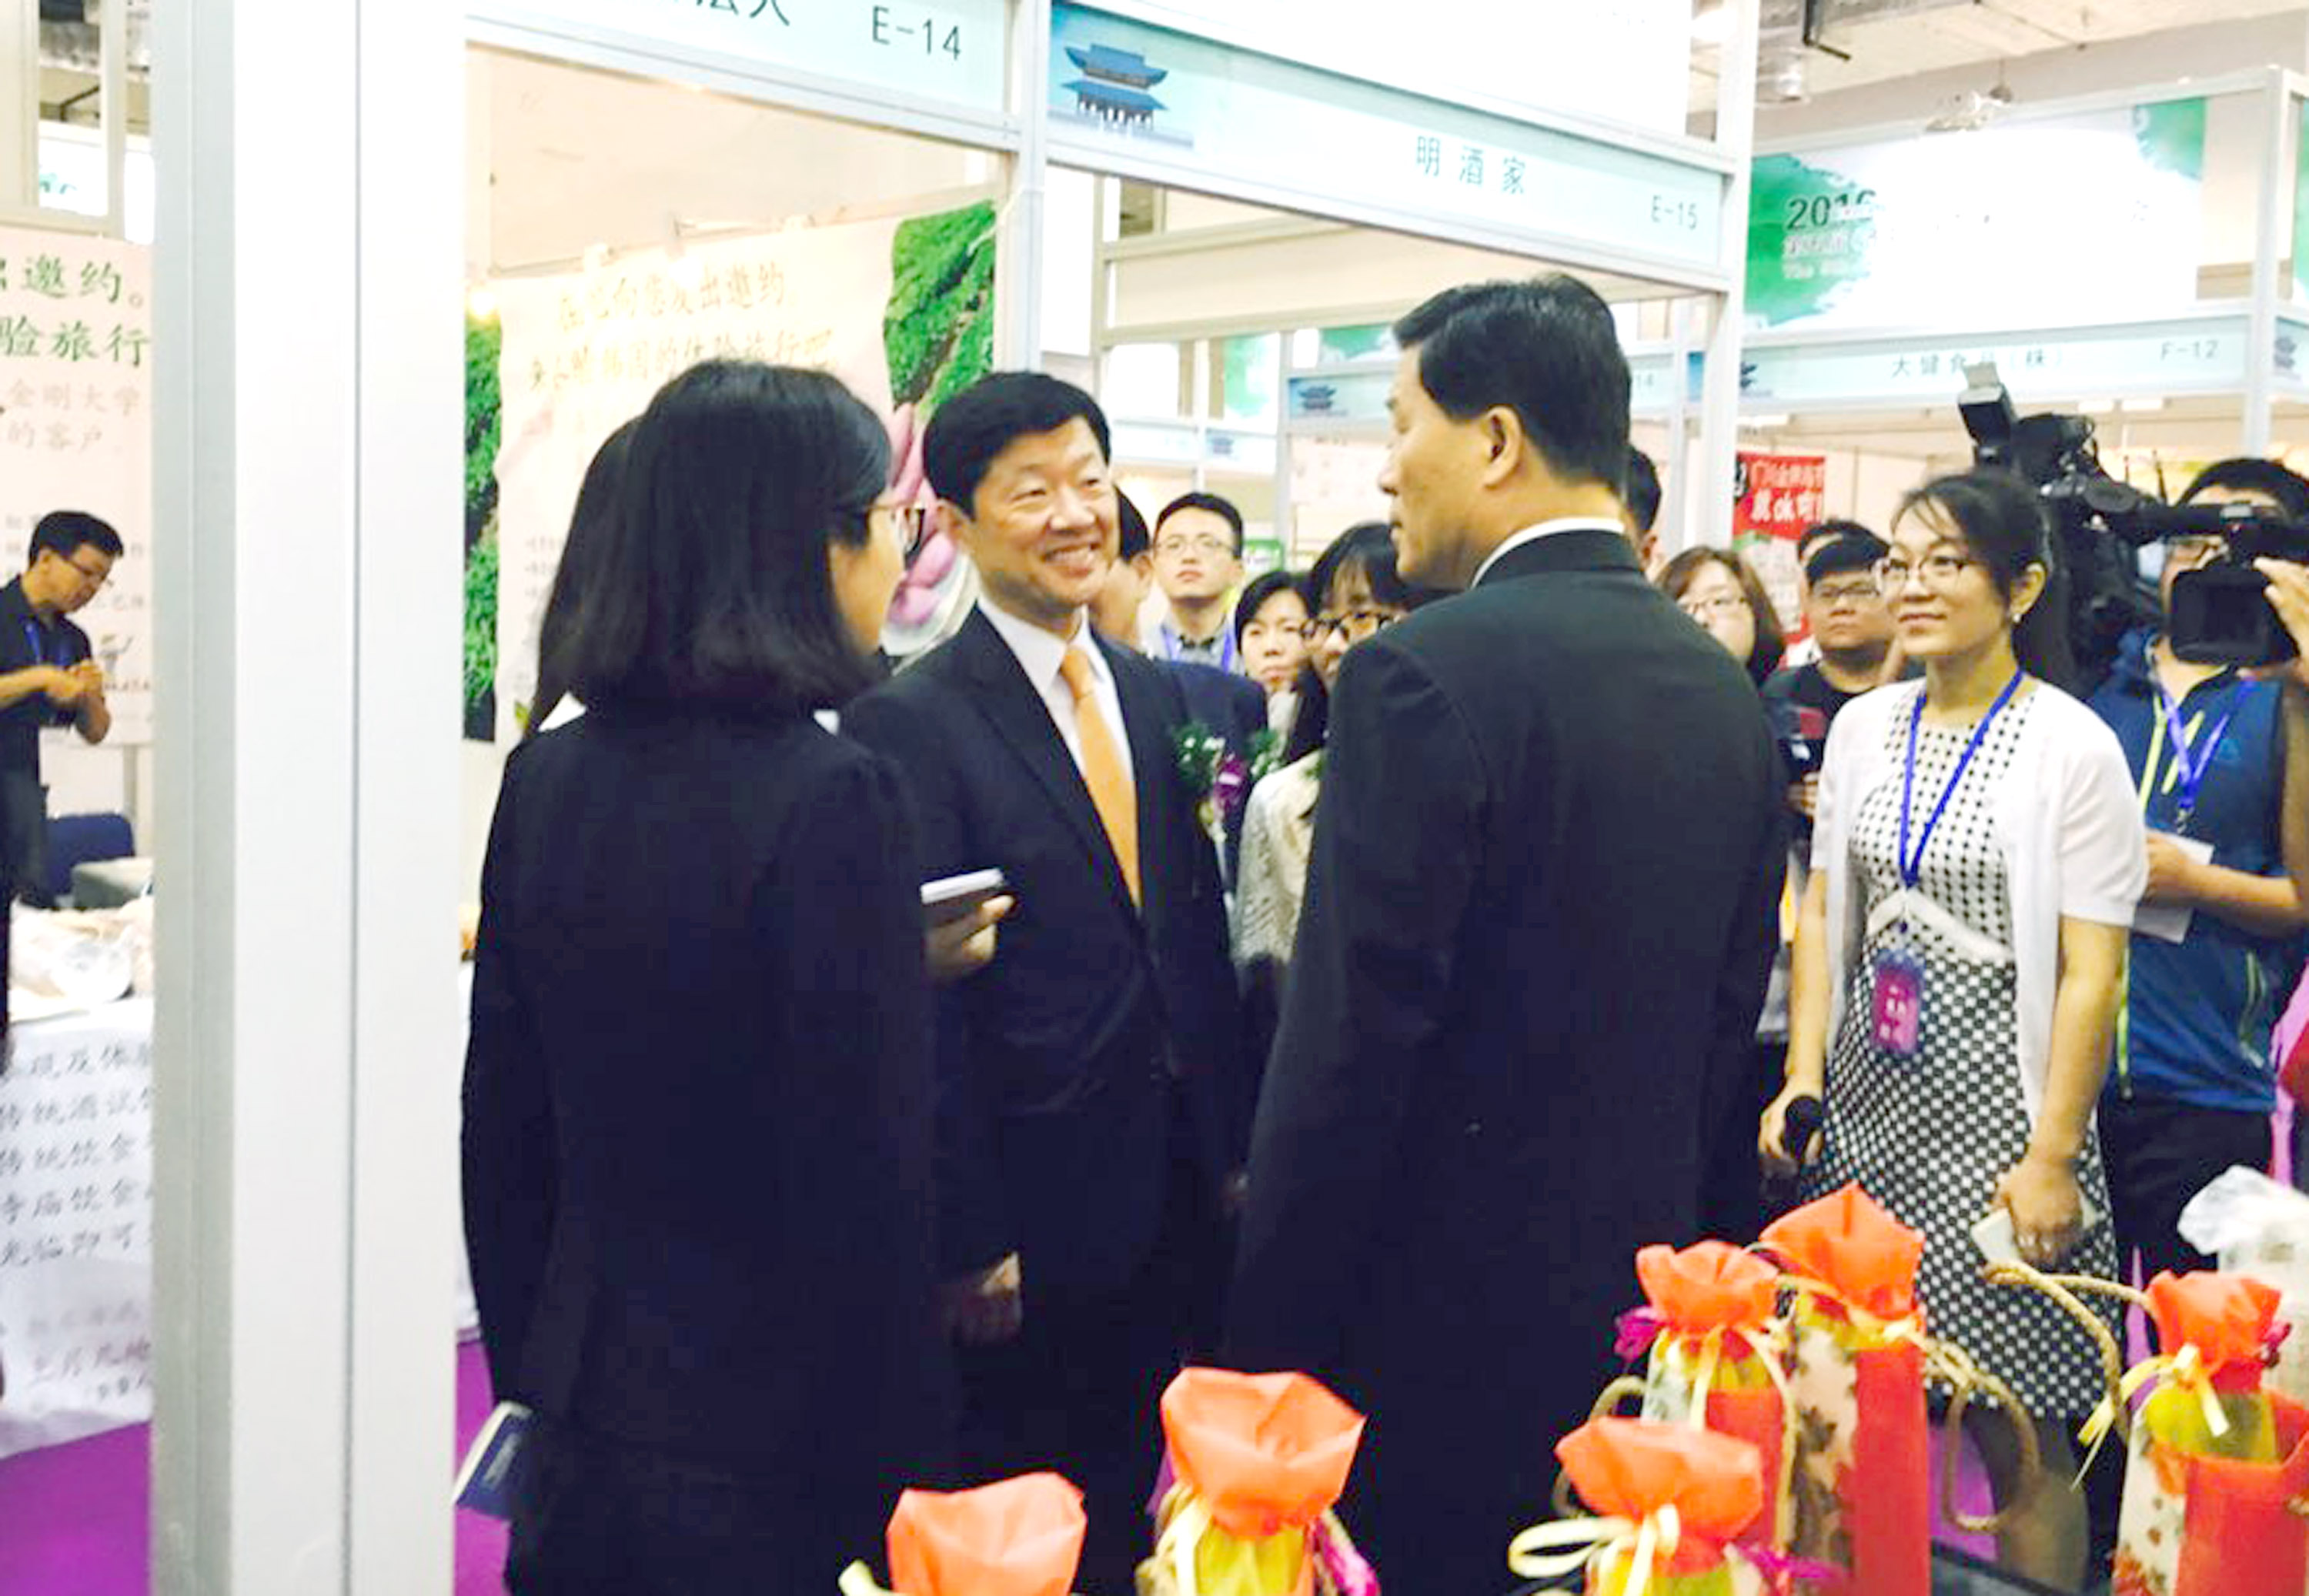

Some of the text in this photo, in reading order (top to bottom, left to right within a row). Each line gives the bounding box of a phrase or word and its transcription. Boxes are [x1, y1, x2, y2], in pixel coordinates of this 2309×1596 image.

[871, 5, 962, 61] E-14
[1416, 135, 1526, 195] 明酒家
[1651, 195, 1698, 230] E-15
[0, 255, 144, 308] 邀约。
[2160, 339, 2220, 361] F-12
